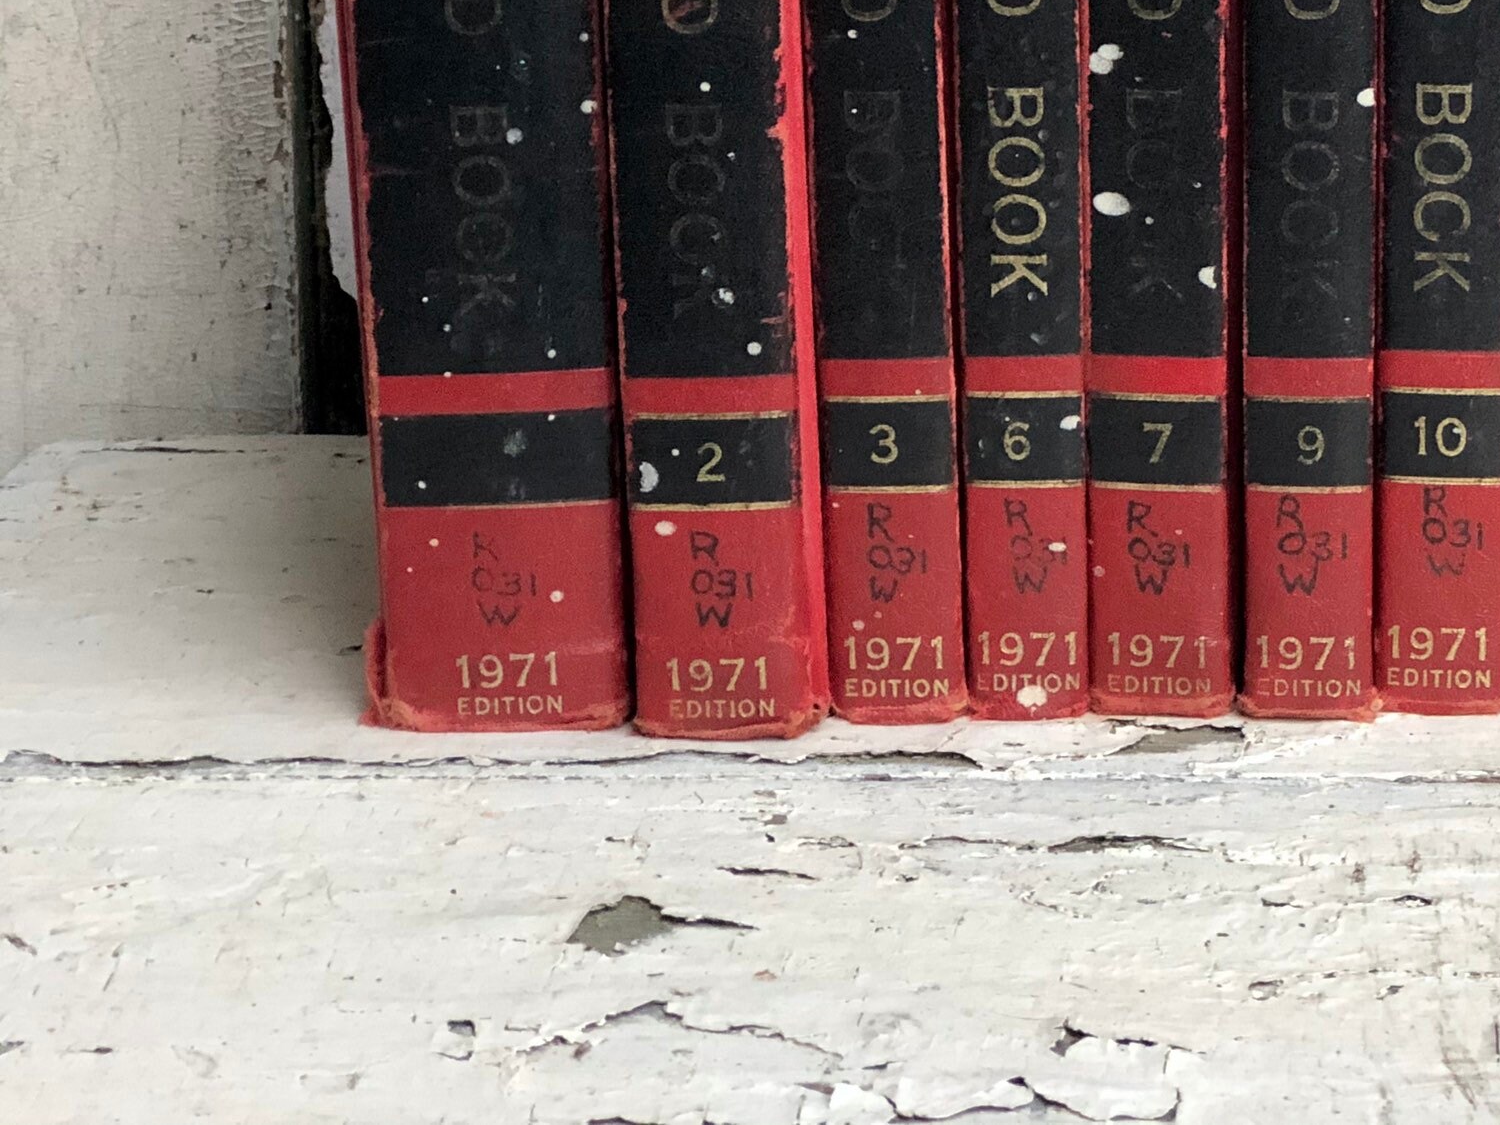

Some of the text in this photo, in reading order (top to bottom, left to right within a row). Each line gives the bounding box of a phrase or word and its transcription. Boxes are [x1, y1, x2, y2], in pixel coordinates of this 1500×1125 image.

[986, 85, 1049, 297] BOOK
[1412, 81, 1473, 293] BOOK
[449, 104, 516, 318] BOOK
[868, 424, 899, 464] 3
[1002, 420, 1031, 461] 6
[1142, 421, 1174, 464] 7
[1297, 425, 1326, 466] 9
[1413, 415, 1468, 457] 10
[695, 443, 727, 483] 2
[1003, 497, 1033, 537] R
[1127, 500, 1159, 537] R
[1422, 487, 1448, 516] R
[866, 502, 893, 543] R
[690, 531, 719, 564] R
[1426, 551, 1467, 577] W
[868, 575, 897, 604] W
[1013, 562, 1049, 595] W
[1134, 562, 1169, 596] W
[1277, 557, 1319, 596] W
[477, 599, 521, 626] W
[695, 602, 731, 630] W
[843, 635, 944, 671] 1971
[977, 631, 1078, 668] 1971
[1107, 632, 1208, 669] 1971
[1256, 634, 1357, 672] 1971
[1387, 626, 1488, 662] 1971
[455, 651, 558, 689] 1971
[665, 656, 768, 692] 1971
[844, 677, 949, 699] EDITION
[977, 673, 1081, 693] EDITION
[1107, 674, 1213, 695] EDITION
[1256, 677, 1362, 699] EDITION
[1387, 667, 1492, 689] EDITION
[457, 695, 563, 716] EDITION
[668, 698, 775, 720] EDITION
